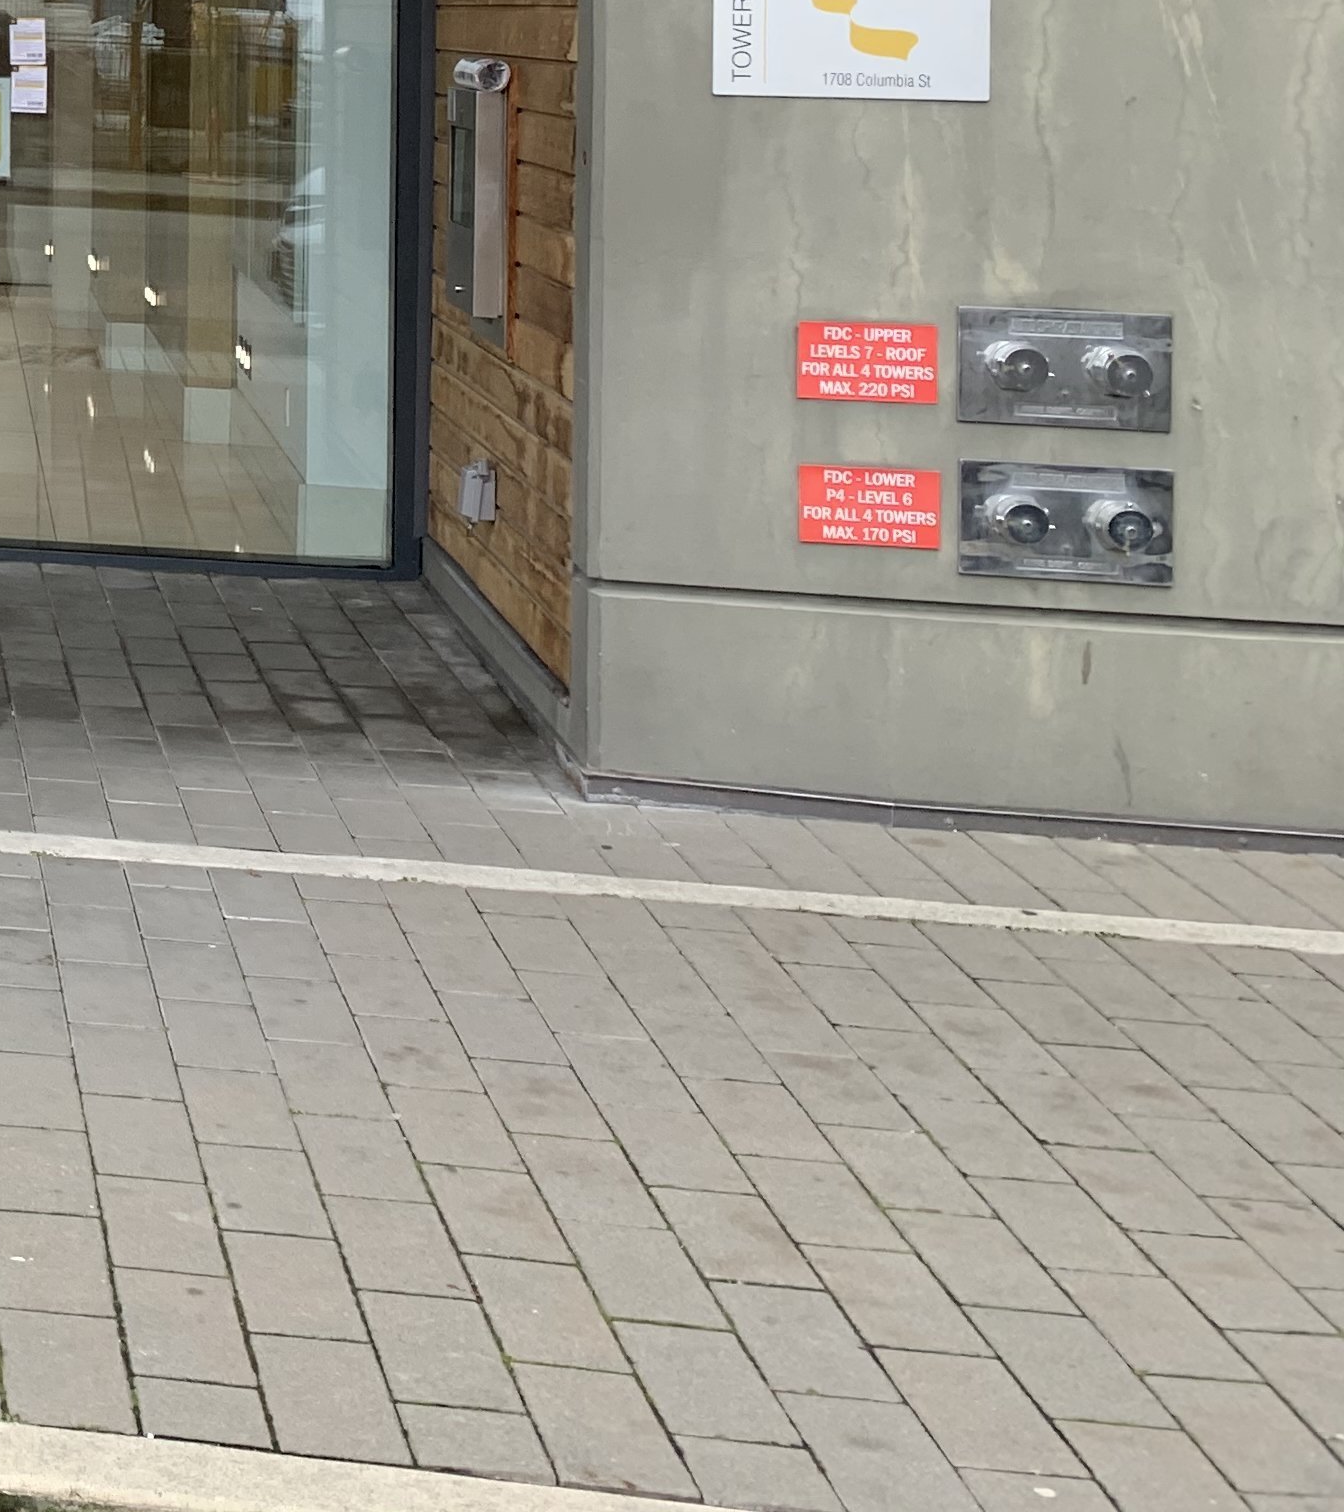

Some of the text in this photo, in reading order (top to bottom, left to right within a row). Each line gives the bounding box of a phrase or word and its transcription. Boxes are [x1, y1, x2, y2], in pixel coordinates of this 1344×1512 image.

[822, 72, 932, 88] 1708 Columbia St
[823, 326, 852, 341] FDC
[863, 327, 912, 344] UPPER
[809, 343, 861, 360] LEVELS
[864, 346, 875, 360] 7
[885, 347, 927, 362] ROOF
[801, 361, 935, 381] FOR ALL 4 TOWERS
[819, 380, 915, 399] MAX. 220 PSI
[823, 469, 853, 485] FDC
[864, 471, 916, 488] LOWER
[826, 488, 846, 502] P4
[857, 490, 900, 506] LEVEL
[902, 492, 913, 506] 6
[803, 505, 937, 526] FOR ALL 4 TOWERS
[822, 525, 917, 544] MAX. 170 PSI
